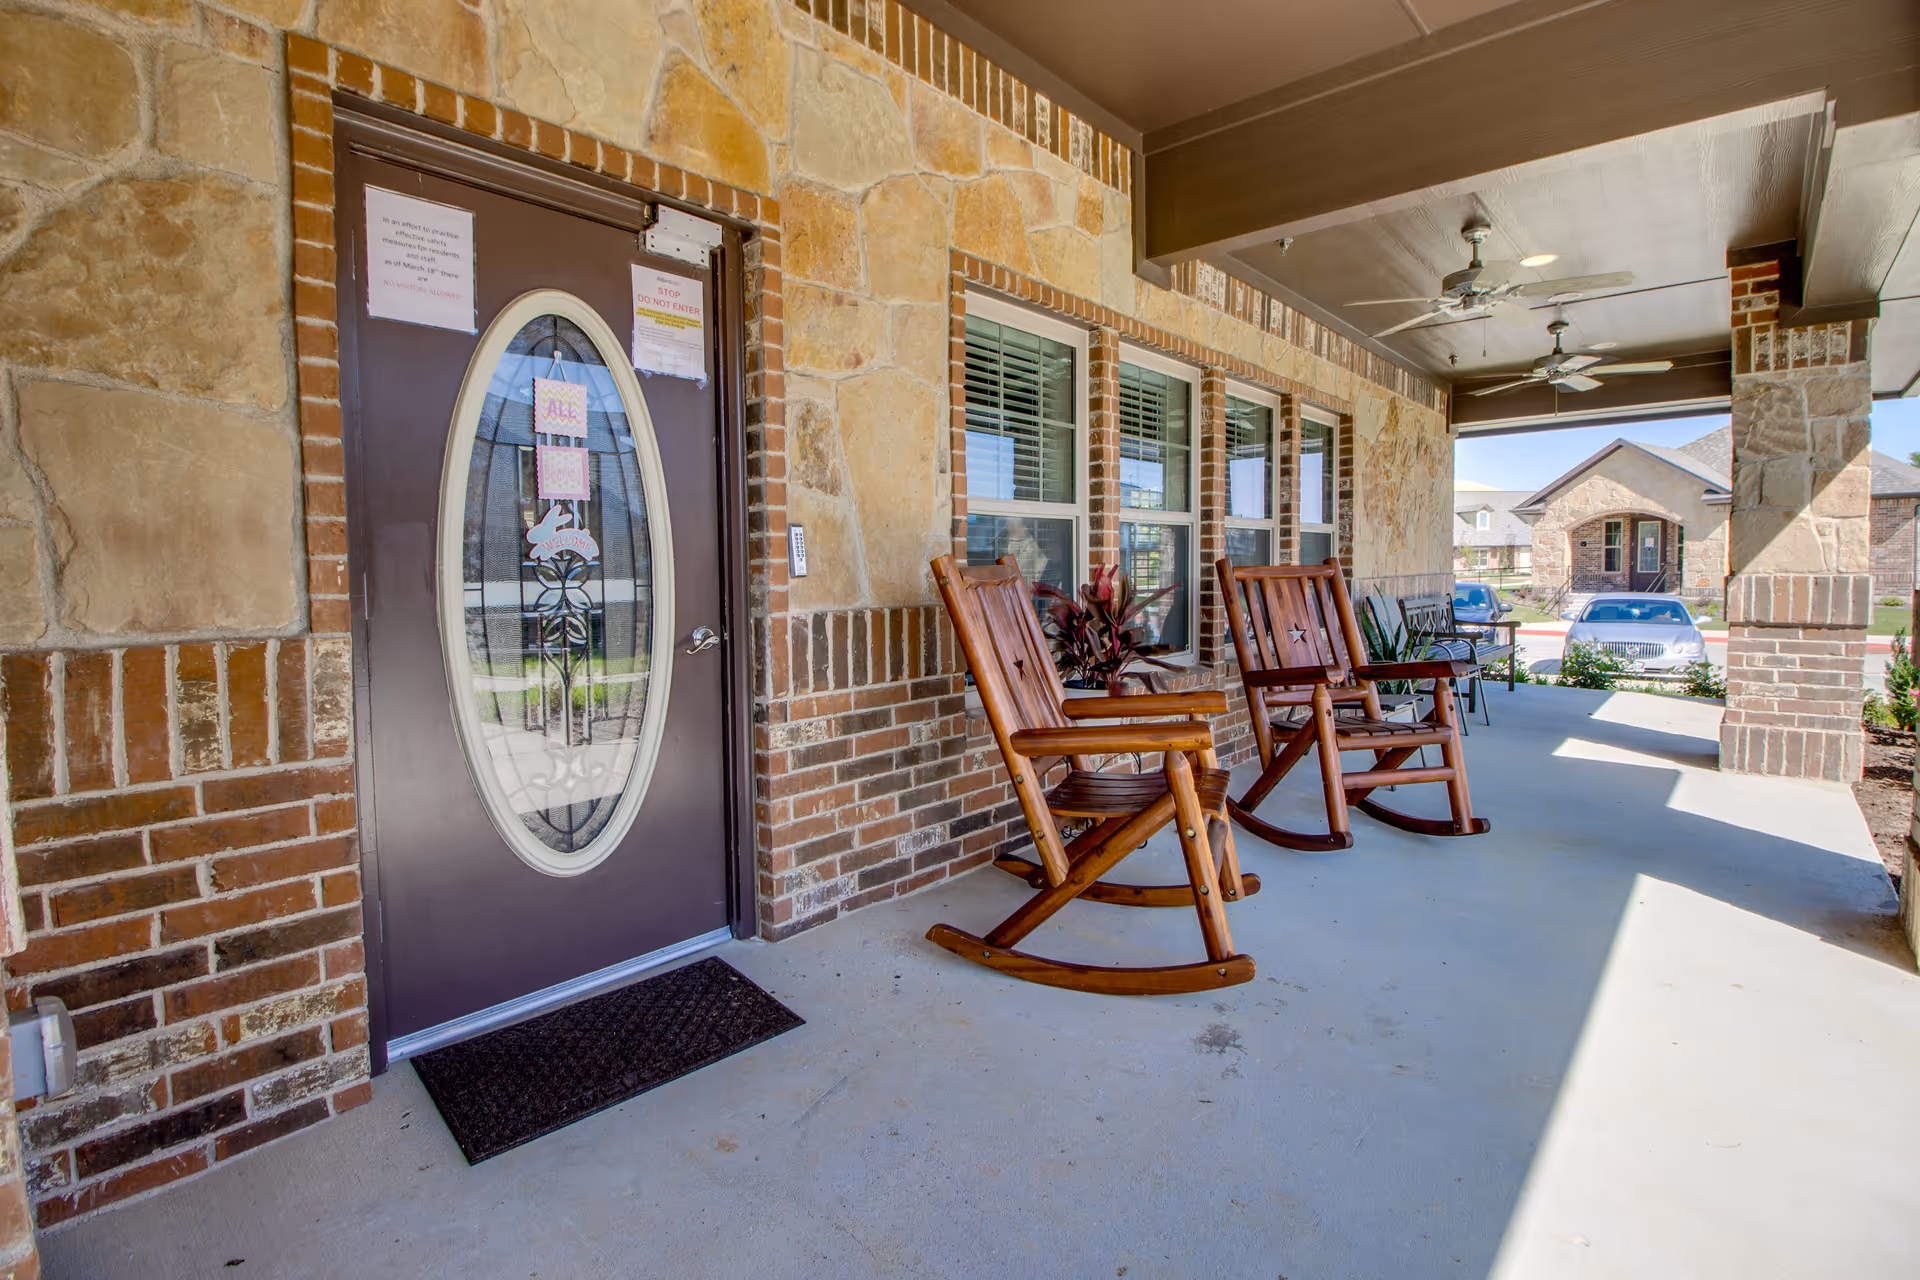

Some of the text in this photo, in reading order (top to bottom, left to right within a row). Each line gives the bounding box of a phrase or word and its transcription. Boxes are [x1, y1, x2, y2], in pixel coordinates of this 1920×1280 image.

[396, 231, 446, 246] effective safety
[402, 222, 422, 230] effort
[432, 229, 460, 239] practice
[382, 238, 416, 248] measures
[430, 249, 460, 258] residents
[402, 262, 424, 271] March
[440, 271, 458, 279] there
[430, 289, 462, 300] ALLOWED
[658, 287, 680, 298] STOP
[638, 294, 650, 304] DO
[654, 297, 670, 308] NOT
[672, 302, 700, 315] ENTER
[548, 400, 576, 418] ALL
[542, 535, 592, 552] WELCOME
